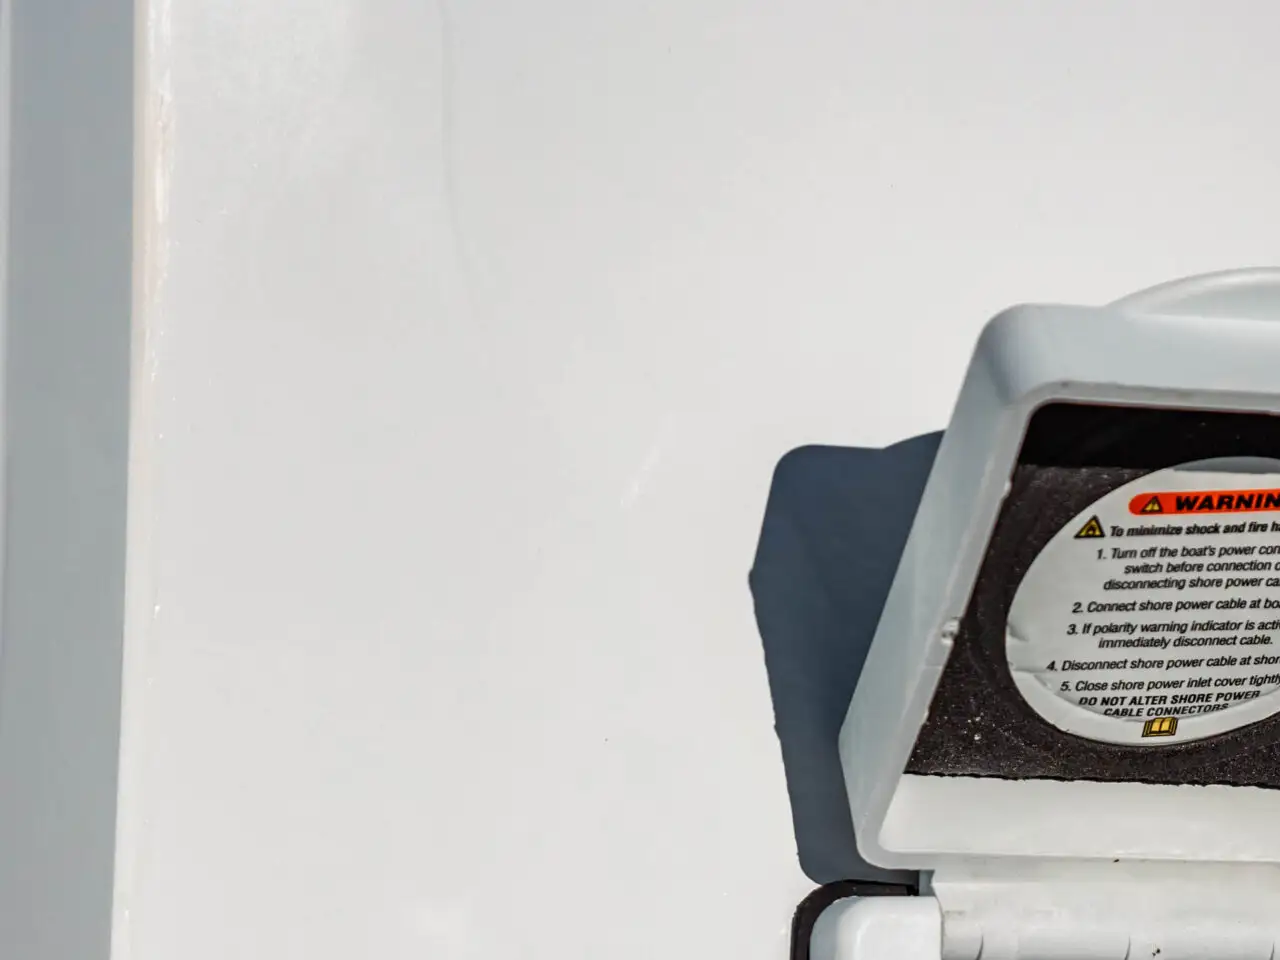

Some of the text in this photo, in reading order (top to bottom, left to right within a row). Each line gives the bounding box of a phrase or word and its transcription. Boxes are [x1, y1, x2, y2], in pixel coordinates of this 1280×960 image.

[1110, 526, 1123, 537] To
[1126, 524, 1182, 537] minimize
[1185, 523, 1220, 535] shock
[1223, 522, 1245, 534] and
[1248, 521, 1268, 533] fire
[1097, 549, 1107, 560] 1.
[1111, 548, 1137, 560] Turn
[1140, 546, 1157, 558] off
[1159, 546, 1178, 558] the
[1180, 545, 1216, 557] boat's
[1218, 546, 1255, 558] power
[1124, 562, 1163, 574] switch
[1166, 561, 1203, 573] before
[1206, 560, 1272, 571] connection
[1103, 578, 1185, 591] disconnecting
[1188, 577, 1222, 588] shore
[1225, 578, 1263, 590] power
[1072, 602, 1084, 613] 2.
[1087, 601, 1136, 613] Connect
[1139, 600, 1173, 611] shore
[1175, 600, 1212, 612] power
[1215, 598, 1247, 609] cable
[1249, 599, 1261, 609] at
[1067, 624, 1078, 635] 3.
[1081, 623, 1092, 634] If
[1093, 622, 1137, 636] polarity
[1141, 622, 1187, 635] warning
[1191, 620, 1243, 631] indicator
[1245, 620, 1255, 630] is
[1098, 634, 1273, 650] immediately disconnect cable.
[1046, 661, 1058, 671] 4.
[1061, 660, 1127, 671] Disconnect
[1130, 658, 1164, 670] shore
[1166, 658, 1203, 671] power
[1206, 655, 1237, 667] cable
[1239, 655, 1251, 665] at
[1060, 681, 1072, 692] 5.
[1075, 680, 1108, 692] Close
[1110, 679, 1145, 690] shore
[1147, 678, 1184, 691] power
[1186, 676, 1212, 688] inlet
[1214, 676, 1247, 687] cover
[1078, 690, 1261, 706] DO NOT ALTER SHORE POWER
[1103, 703, 1229, 717] CABLE CONNECTORS
